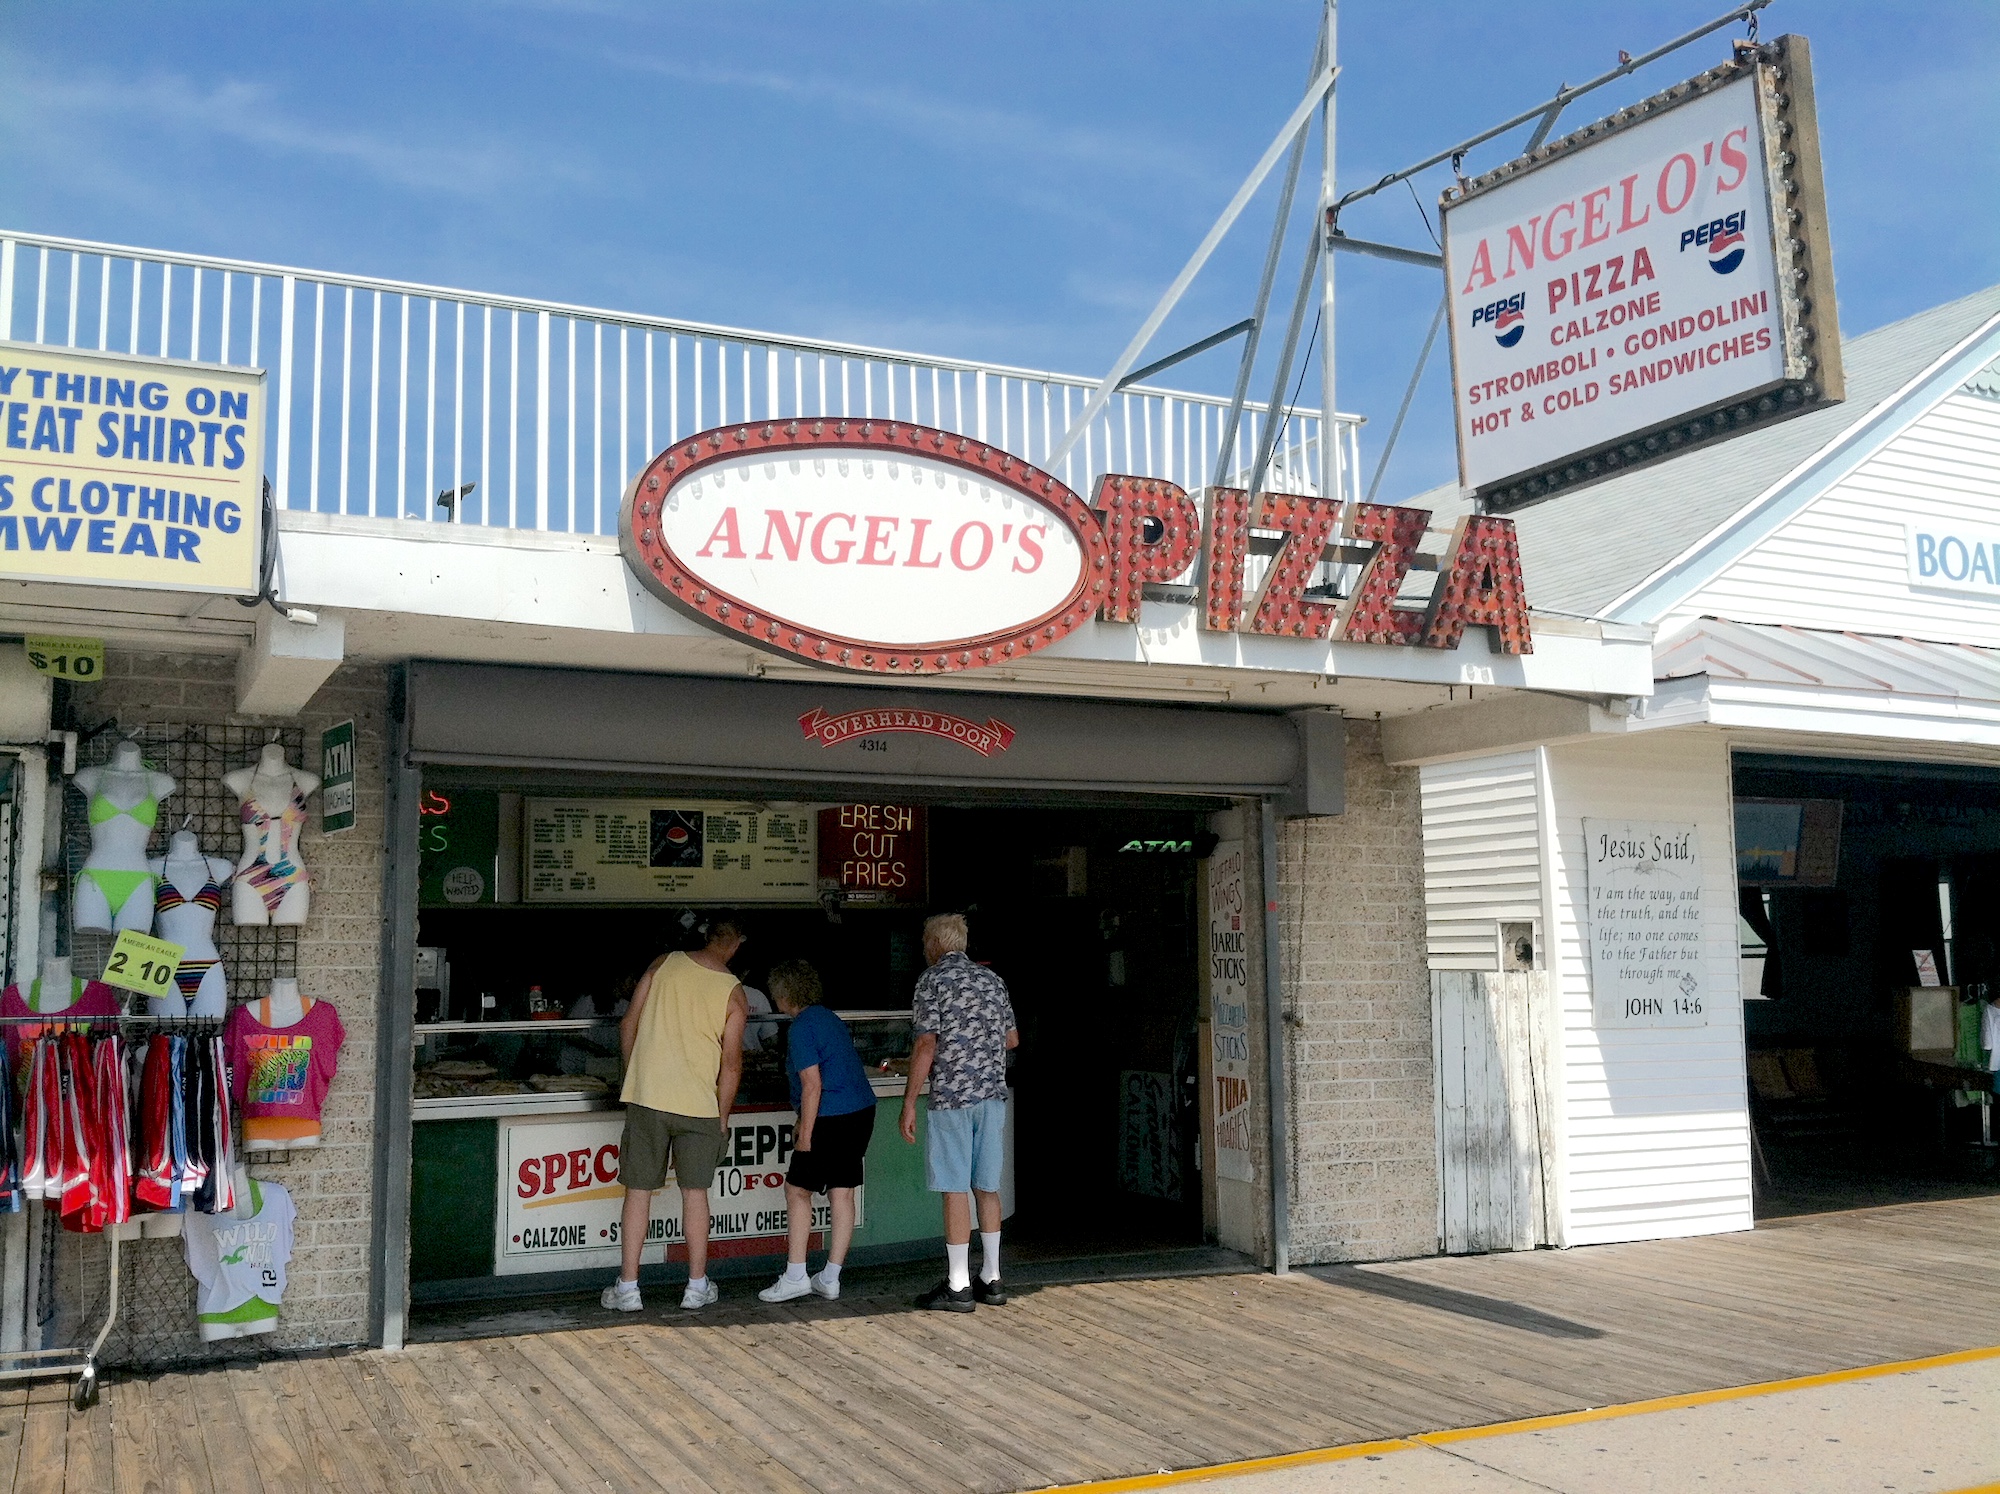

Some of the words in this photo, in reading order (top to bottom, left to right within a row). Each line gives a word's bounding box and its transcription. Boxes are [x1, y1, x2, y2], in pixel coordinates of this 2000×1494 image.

[1461, 126, 1749, 295] ANGELO'S
[1679, 210, 1746, 252] PEPSI
[1547, 246, 1655, 315] PIZZA
[1472, 292, 1526, 328] PEPSI
[1549, 291, 1661, 347] CALZONE
[1468, 349, 1598, 405] STROMBOLI
[1623, 290, 1768, 357] GONDOLINI
[1471, 407, 1511, 437] HOT
[1520, 401, 1536, 422] &
[1542, 381, 1600, 415] COLD
[1609, 327, 1771, 395] SANDWICHES
[185, 387, 248, 420] ON
[96, 411, 246, 470] SHIRTS
[31, 477, 242, 534] CLOTHING
[695, 506, 1046, 574] ANGELO'S
[1093, 473, 1534, 655] PIZZA
[28, 652, 94, 675] $10
[823, 712, 934, 741] OVERHEAD
[940, 718, 991, 751] DOOR
[859, 739, 887, 752] 4314
[324, 741, 351, 781] ATM
[853, 832, 898, 858] CUT
[1118, 840, 1192, 852] ATM
[1598, 834, 1645, 862] Jesus
[1651, 833, 1695, 864] Said,
[446, 884, 479, 896] WANTED
[452, 872, 476, 885] HELP
[843, 861, 906, 887] FRIES
[1606, 889, 1624, 900] am
[1628, 887, 1645, 900] the
[1650, 889, 1676, 906] way,
[1680, 886, 1700, 900] and
[1597, 906, 1616, 920] the
[1620, 906, 1654, 921] truth,
[1658, 905, 1678, 920] and
[1683, 905, 1699, 920] the
[1211, 920, 1245, 953] GARLIC
[1627, 931, 1641, 941] no
[1645, 931, 1664, 941] one
[1668, 931, 1699, 942] comes
[108, 952, 128, 974] 2
[140, 960, 171, 985] 10
[1212, 953, 1246, 987] STICKS
[1601, 948, 1613, 960] to
[1618, 947, 1636, 960] the
[1639, 946, 1677, 962] Father
[1680, 946, 1699, 960] but
[1619, 965, 1663, 984] through
[1625, 998, 1663, 1019] JOHN
[1673, 998, 1702, 1015] 14:6
[243, 1034, 312, 1049] WILD
[1214, 1032, 1248, 1063] STICKS
[1217, 1076, 1248, 1117] TUNA
[1217, 1108, 1250, 1152] HOAGIES
[717, 1167, 742, 1198] 10
[212, 1221, 277, 1248] WILD
[523, 1225, 586, 1249] CALZONE
